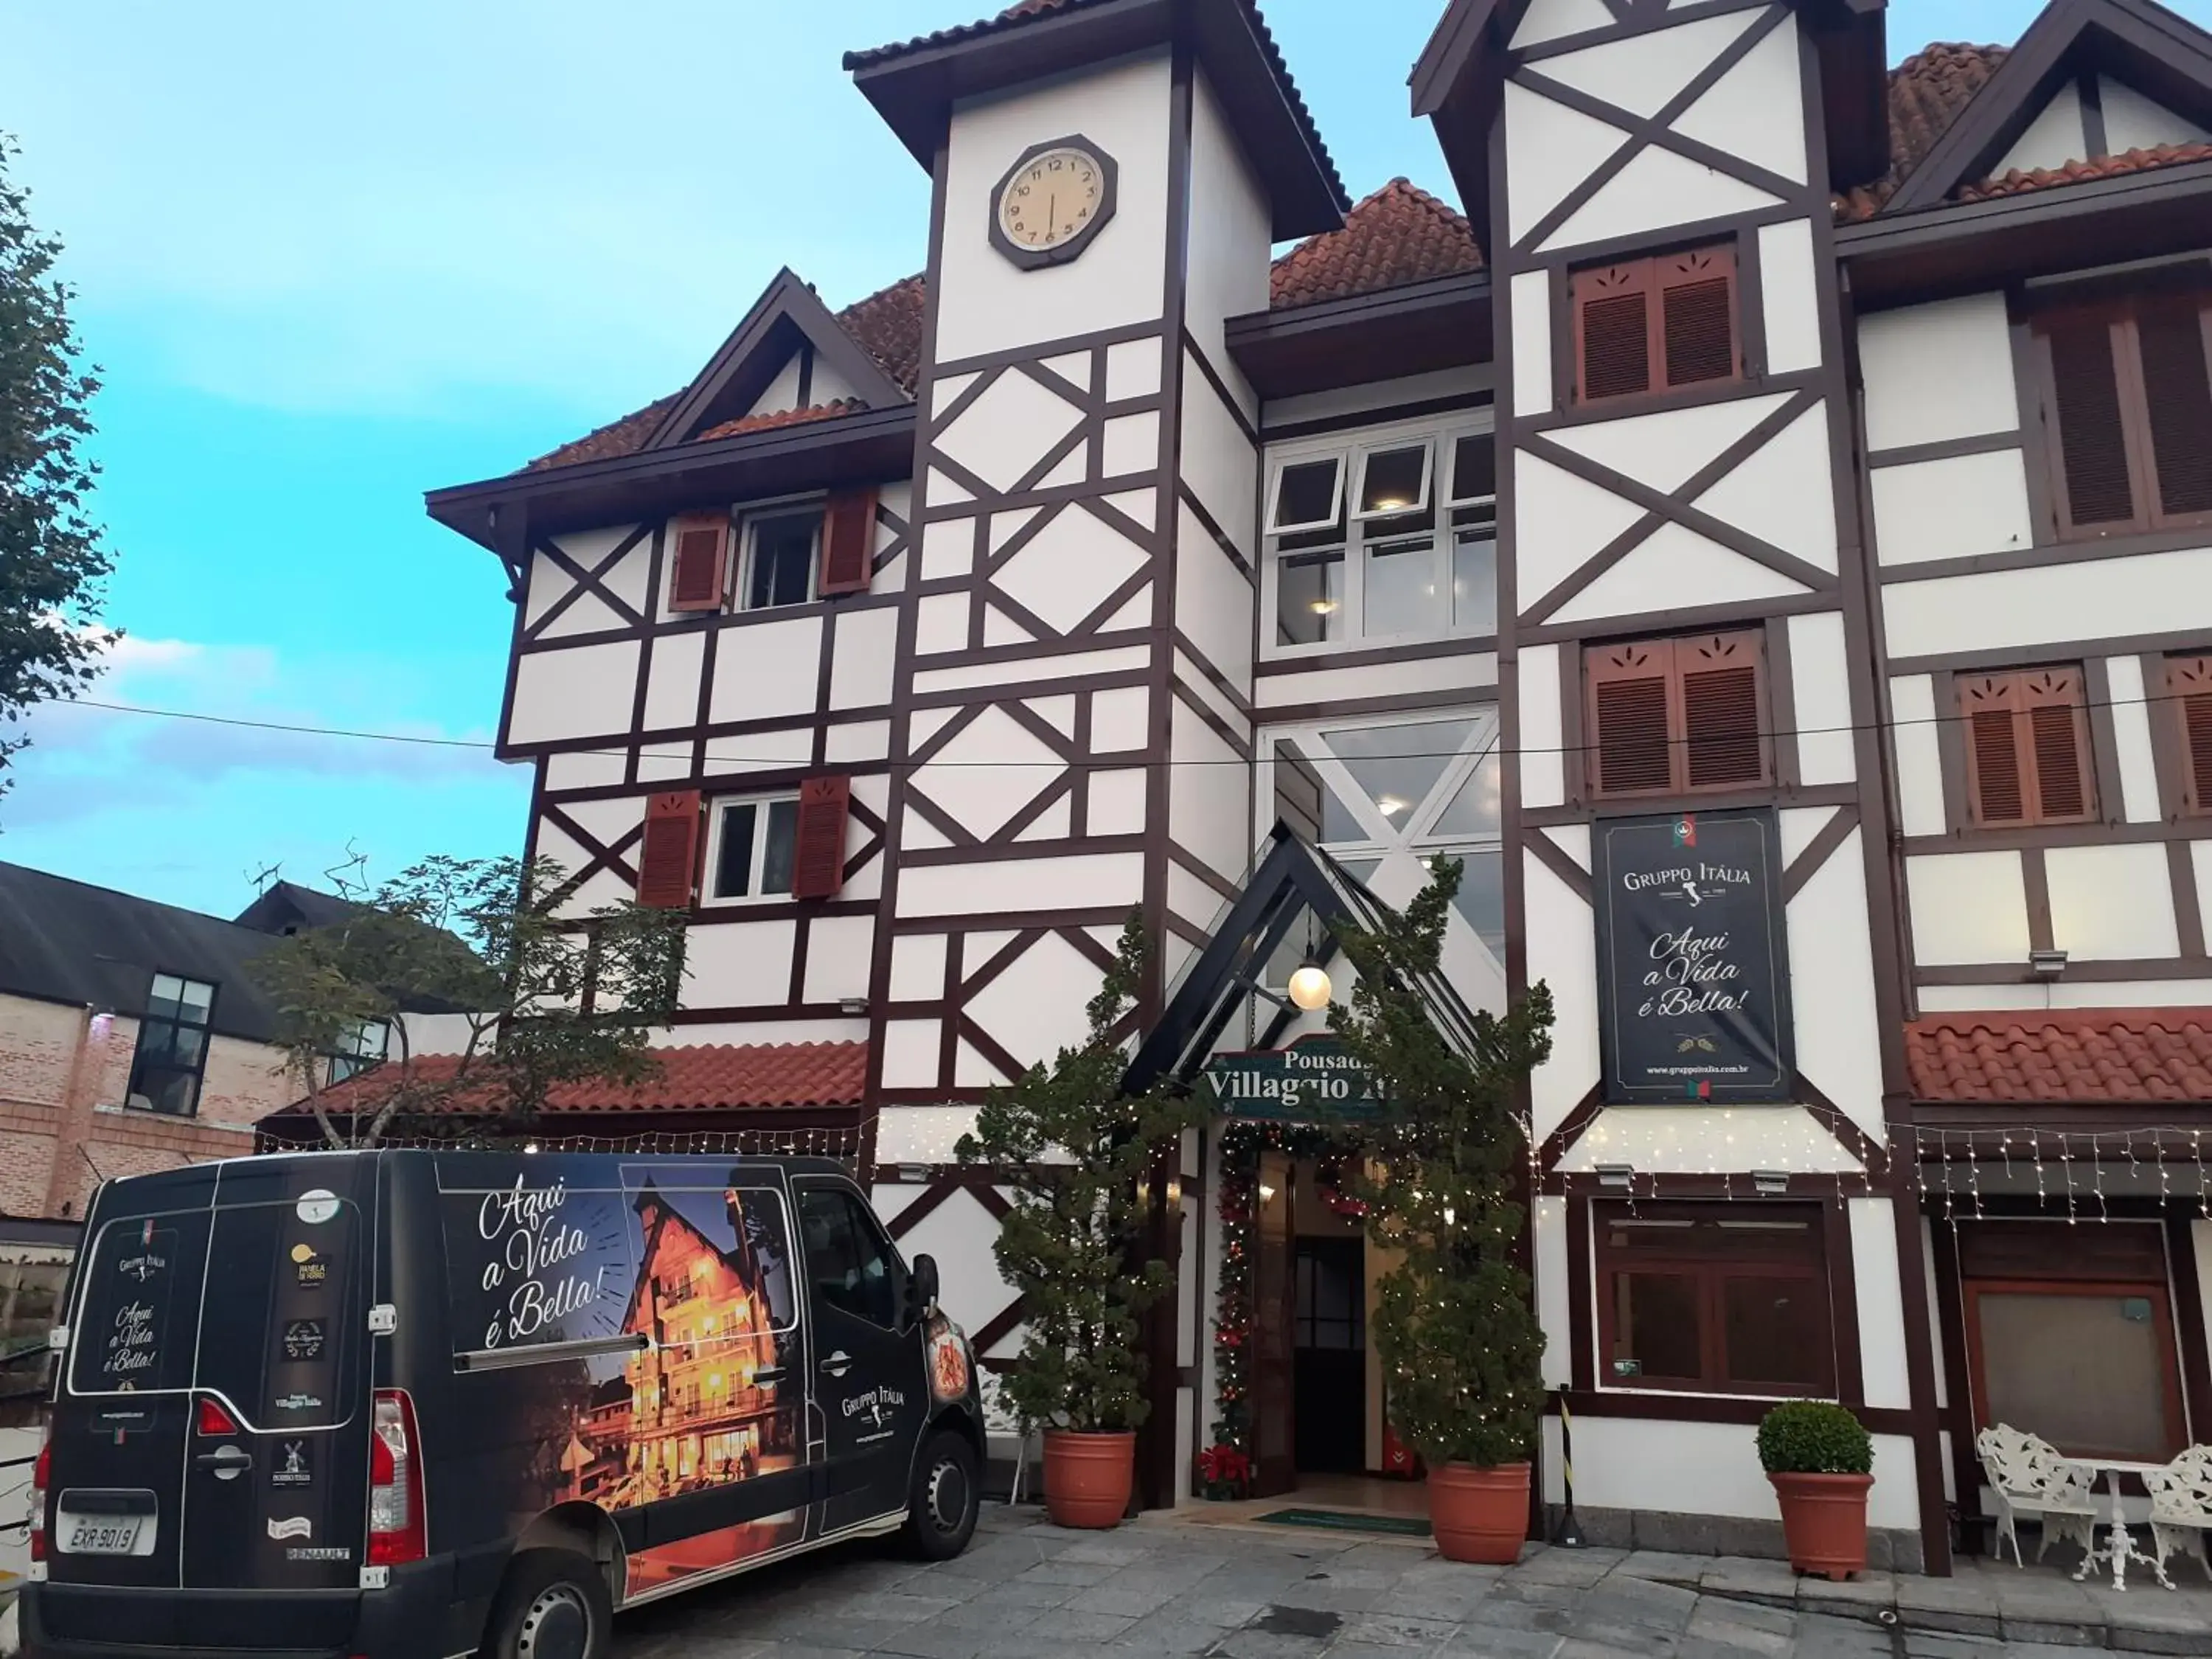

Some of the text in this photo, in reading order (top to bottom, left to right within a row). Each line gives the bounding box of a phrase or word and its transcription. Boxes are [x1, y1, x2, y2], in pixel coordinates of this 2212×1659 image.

[1048, 159, 1062, 171] 12
[1071, 161, 1075, 171] 1
[1032, 170, 1042, 181] 11
[1082, 172, 1091, 182] 2
[1018, 186, 1030, 197] 10
[1086, 187, 1095, 198] 3
[1010, 206, 1020, 216] 9
[1078, 207, 1086, 218] 4
[1015, 222, 1024, 232] 8
[1064, 224, 1073, 234] 5
[1028, 232, 1037, 242] 7
[1046, 232, 1054, 243] 6
[1624, 868, 1691, 891] GRUPPO
[1650, 925, 1730, 961] Aqui
[1644, 953, 1741, 985] a Vida
[1638, 987, 1749, 1017] é Bella!
[1284, 1051, 1373, 1069] Pousad
[479, 1172, 566, 1239] Aqui
[483, 1215, 588, 1291] a Vida
[115, 1300, 154, 1327] Aqui
[485, 1266, 604, 1349] é Bella!
[120, 1322, 154, 1347] Vida
[112, 1349, 157, 1372] Bella!
[286, 1548, 350, 1560] RENAULT
